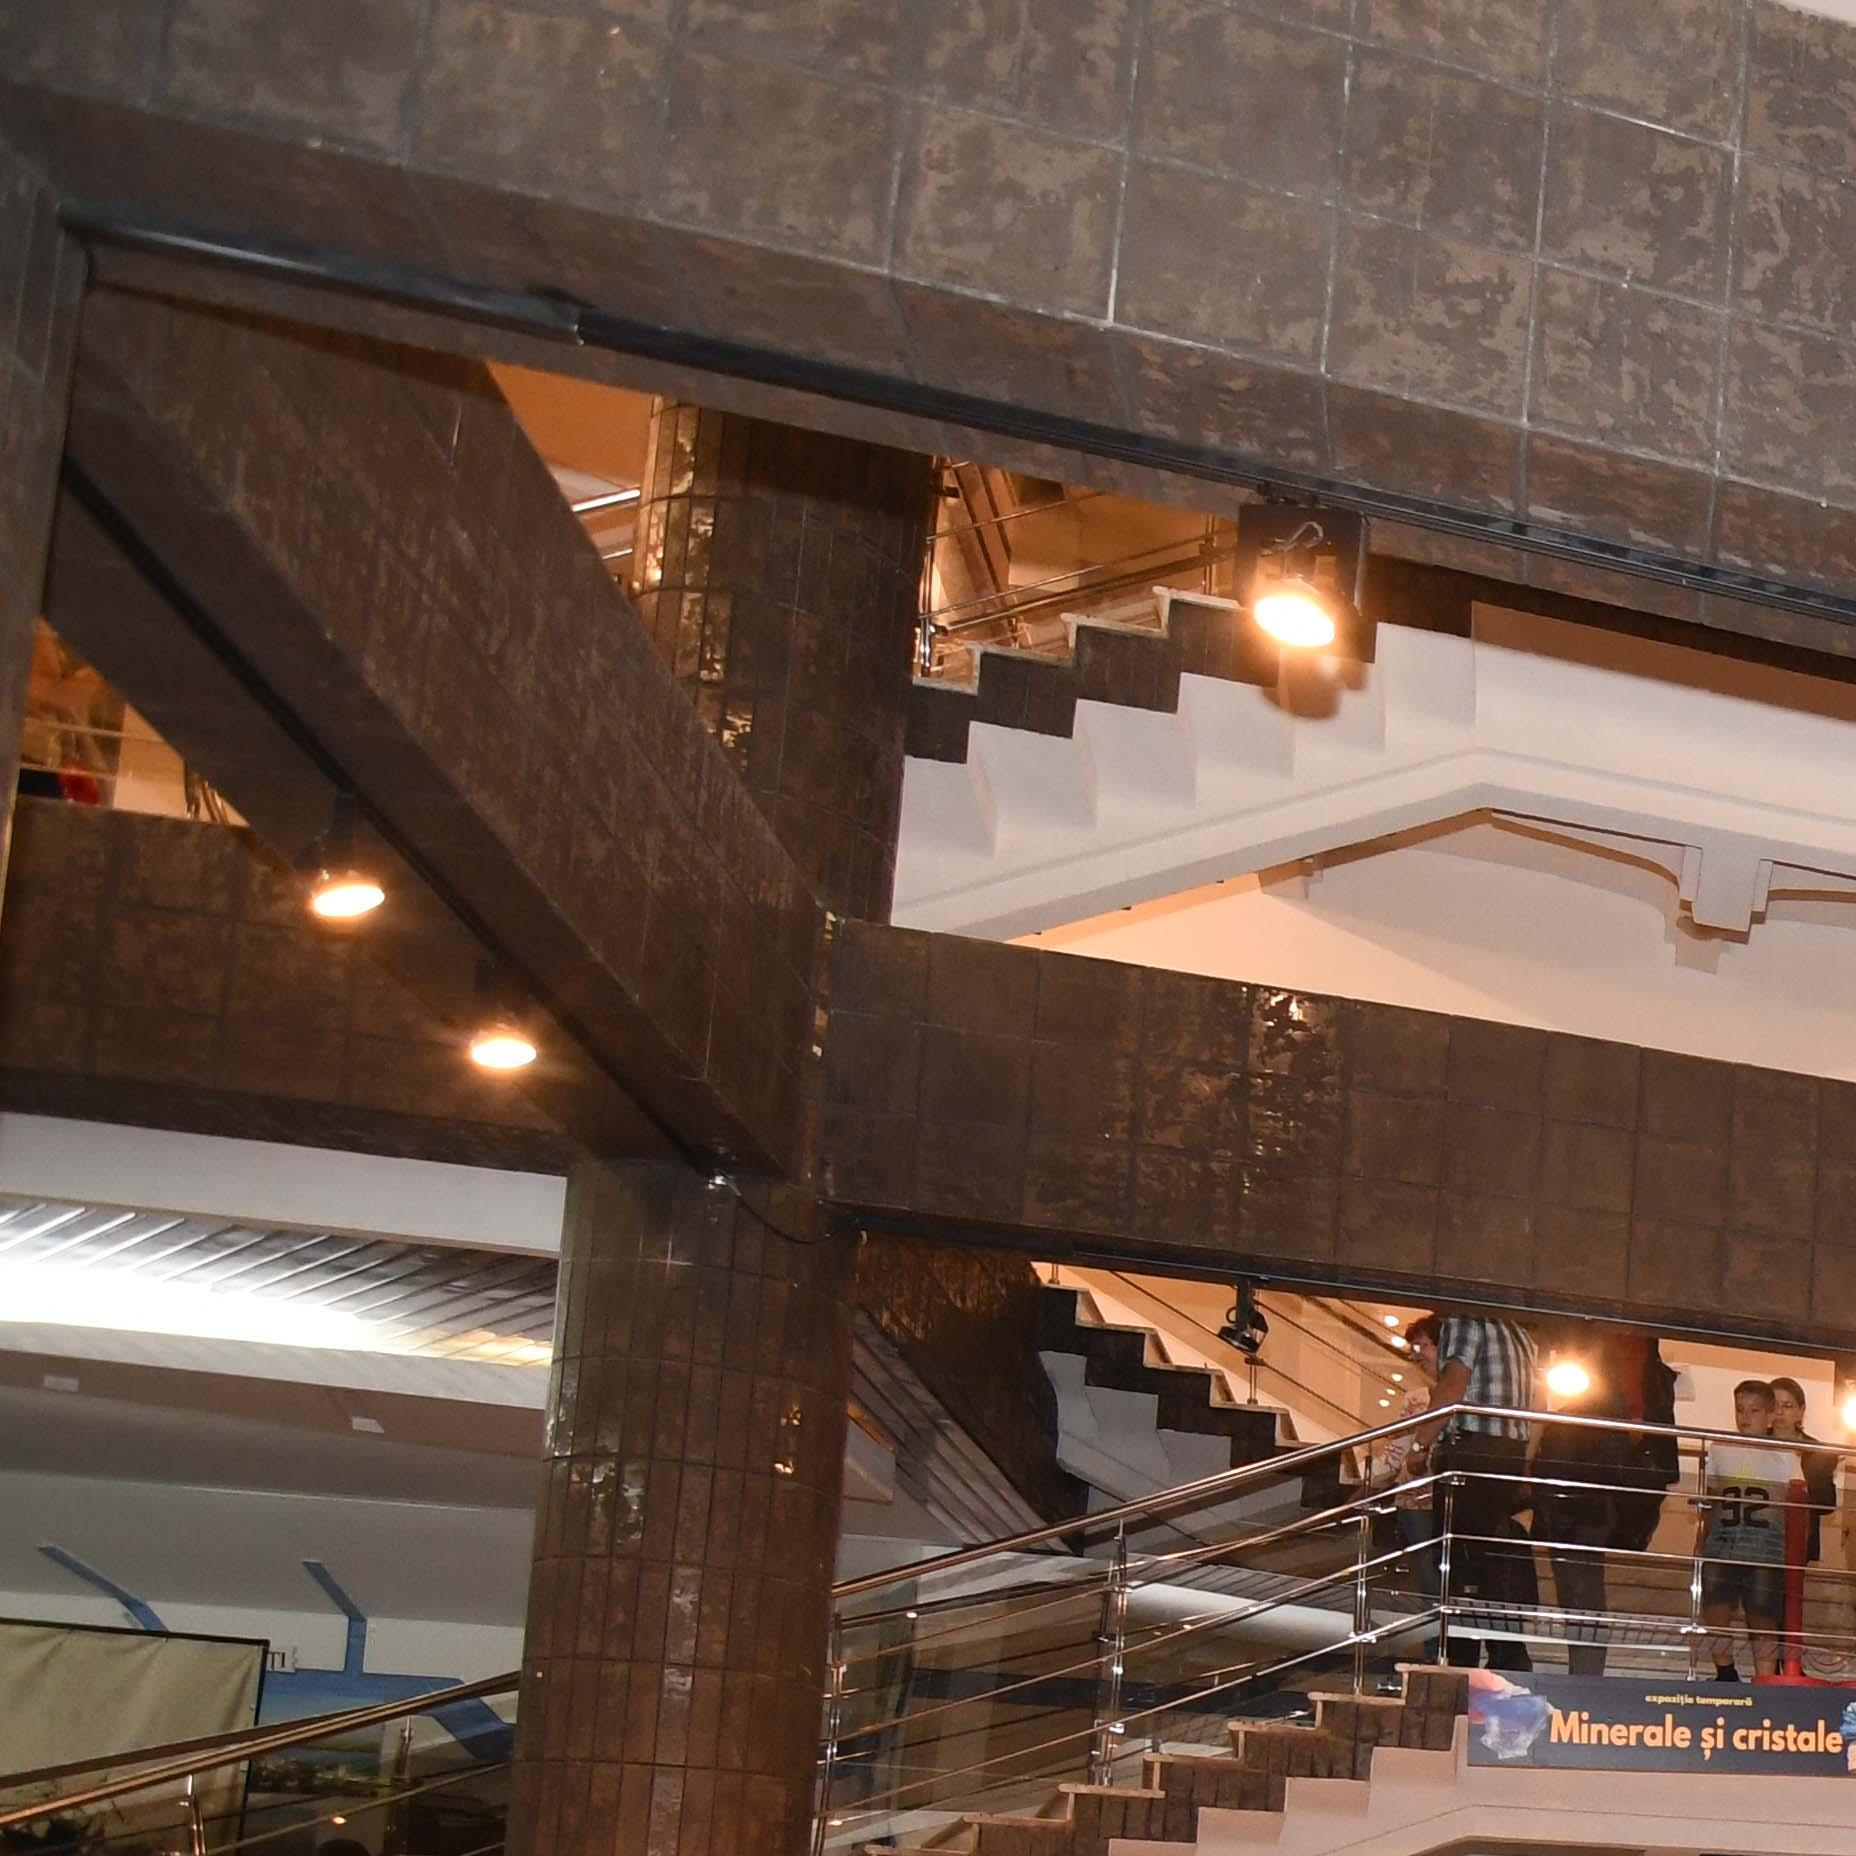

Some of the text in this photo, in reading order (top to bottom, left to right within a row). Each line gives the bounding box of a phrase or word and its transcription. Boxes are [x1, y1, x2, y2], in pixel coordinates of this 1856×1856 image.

[1550, 1709, 1844, 1760] Minerale și cristale
